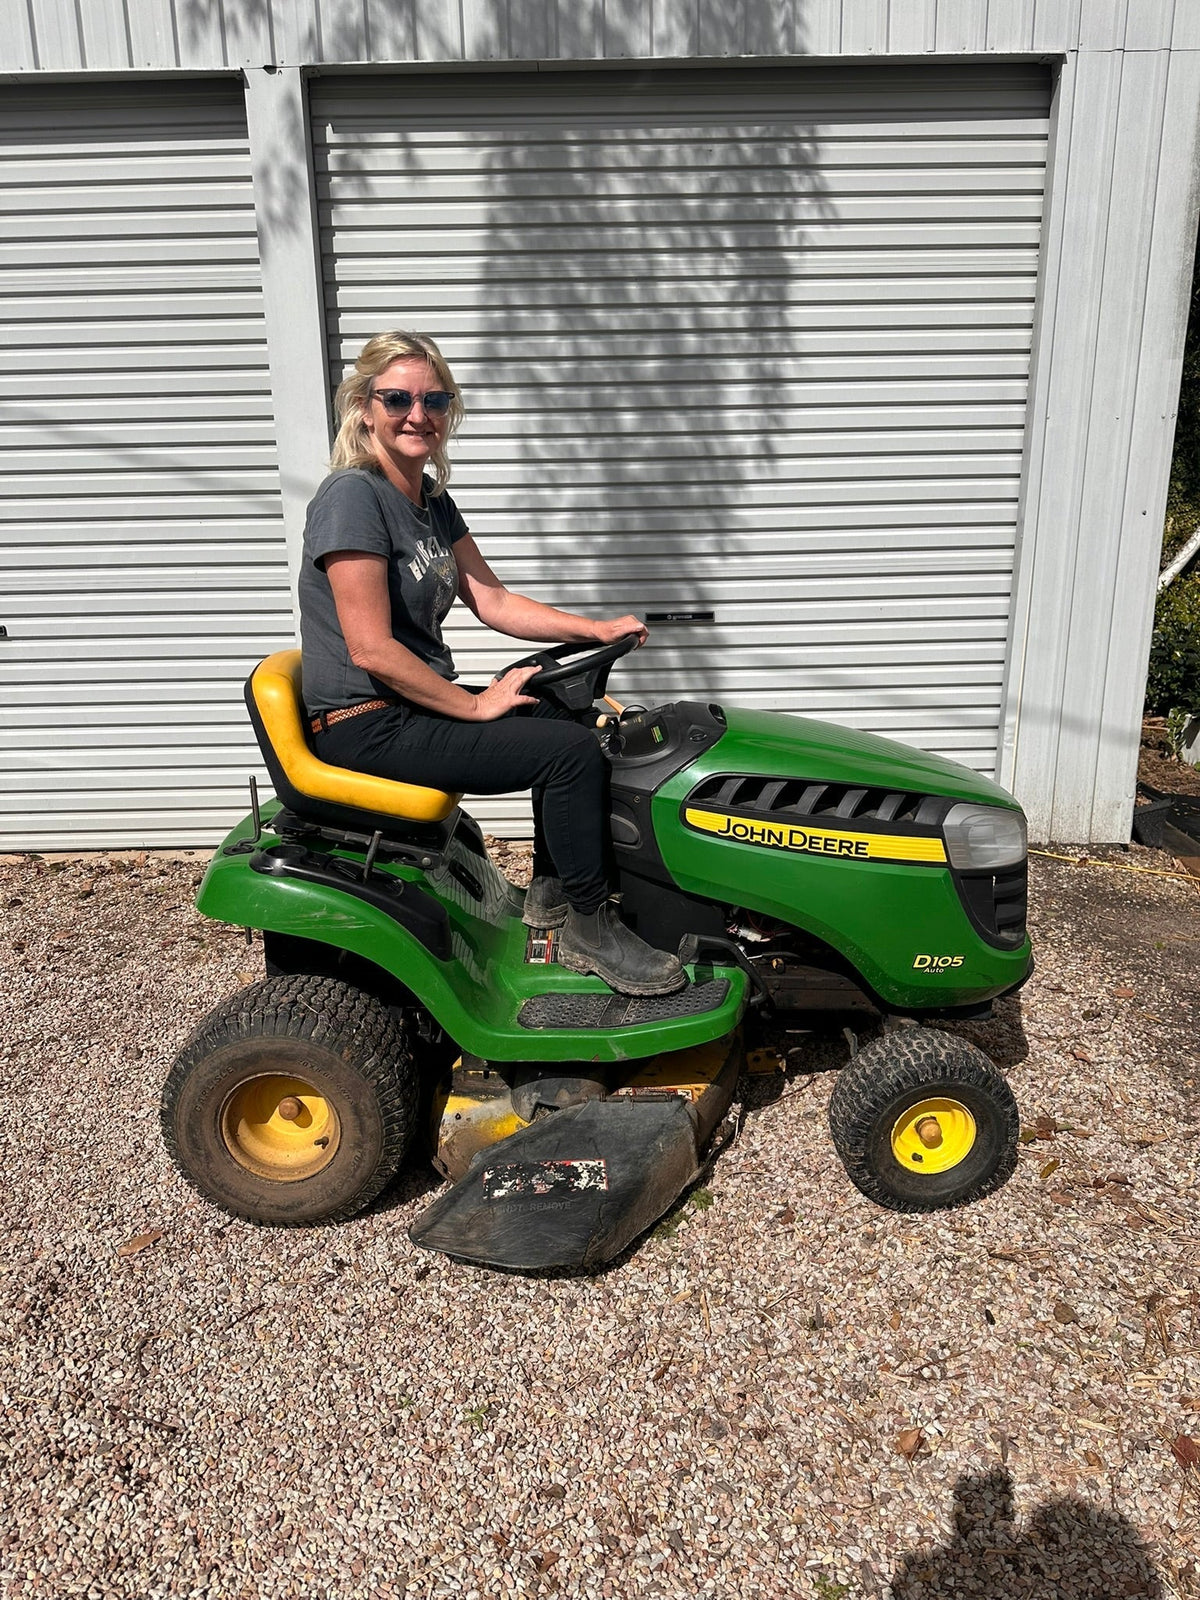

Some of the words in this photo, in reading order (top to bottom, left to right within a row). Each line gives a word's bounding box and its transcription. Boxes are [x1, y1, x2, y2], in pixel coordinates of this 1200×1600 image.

[717, 818, 784, 846] JOHN
[788, 830, 869, 856] DEERE
[912, 954, 965, 968] D105
[194, 1065, 234, 1112] CARLISLE
